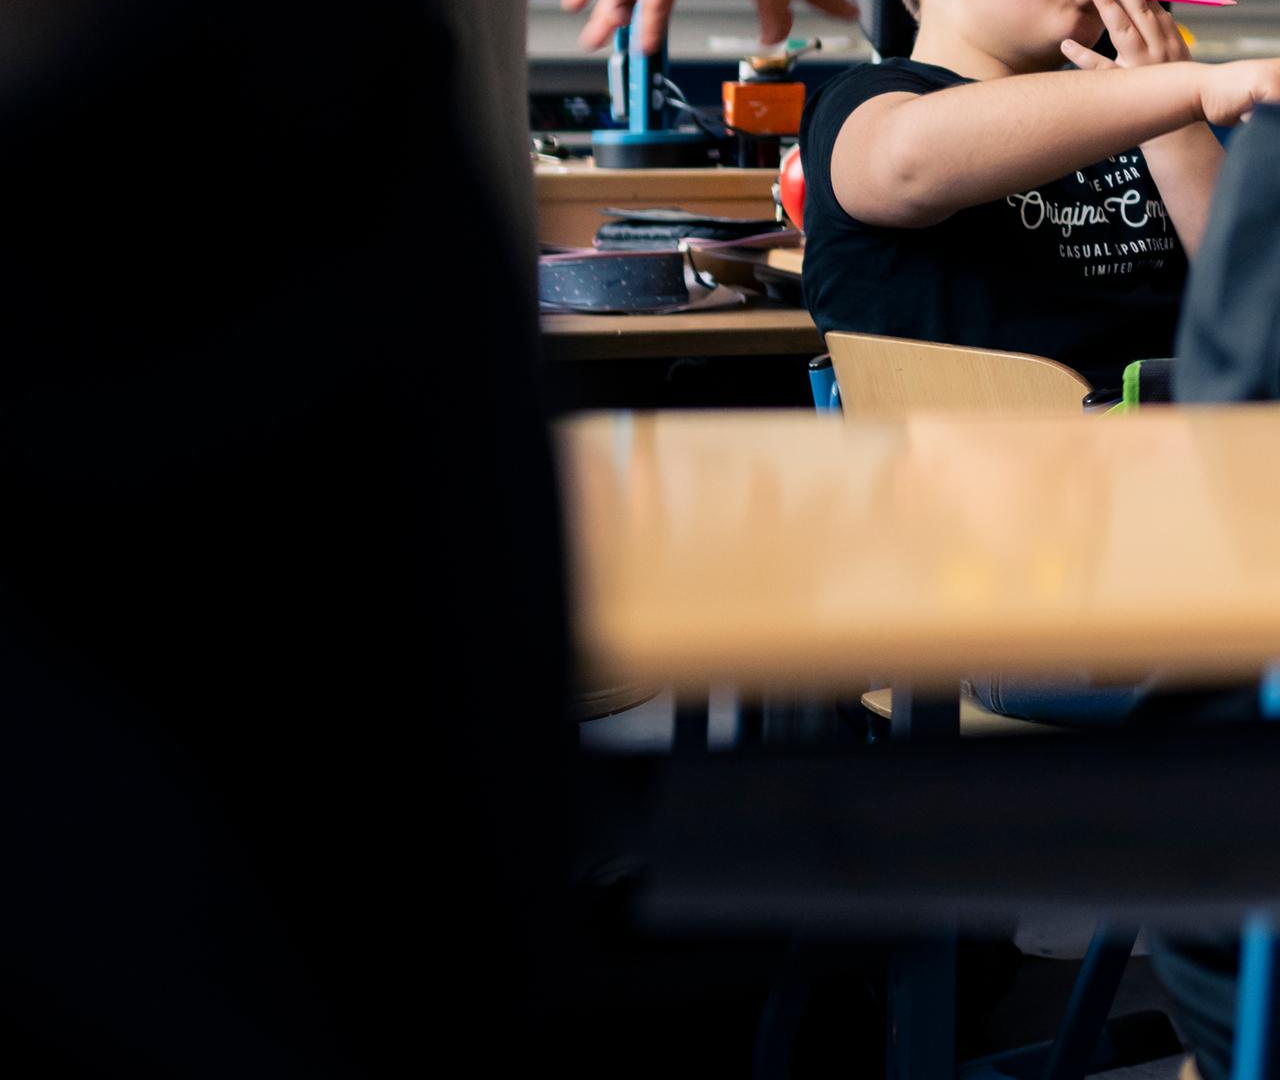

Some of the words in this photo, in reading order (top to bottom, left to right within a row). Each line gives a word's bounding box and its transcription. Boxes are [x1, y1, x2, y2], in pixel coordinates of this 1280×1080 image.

[1104, 166, 1142, 189] YEAR
[1059, 242, 1112, 260] CASUAL
[1084, 262, 1133, 277] LIMITED
